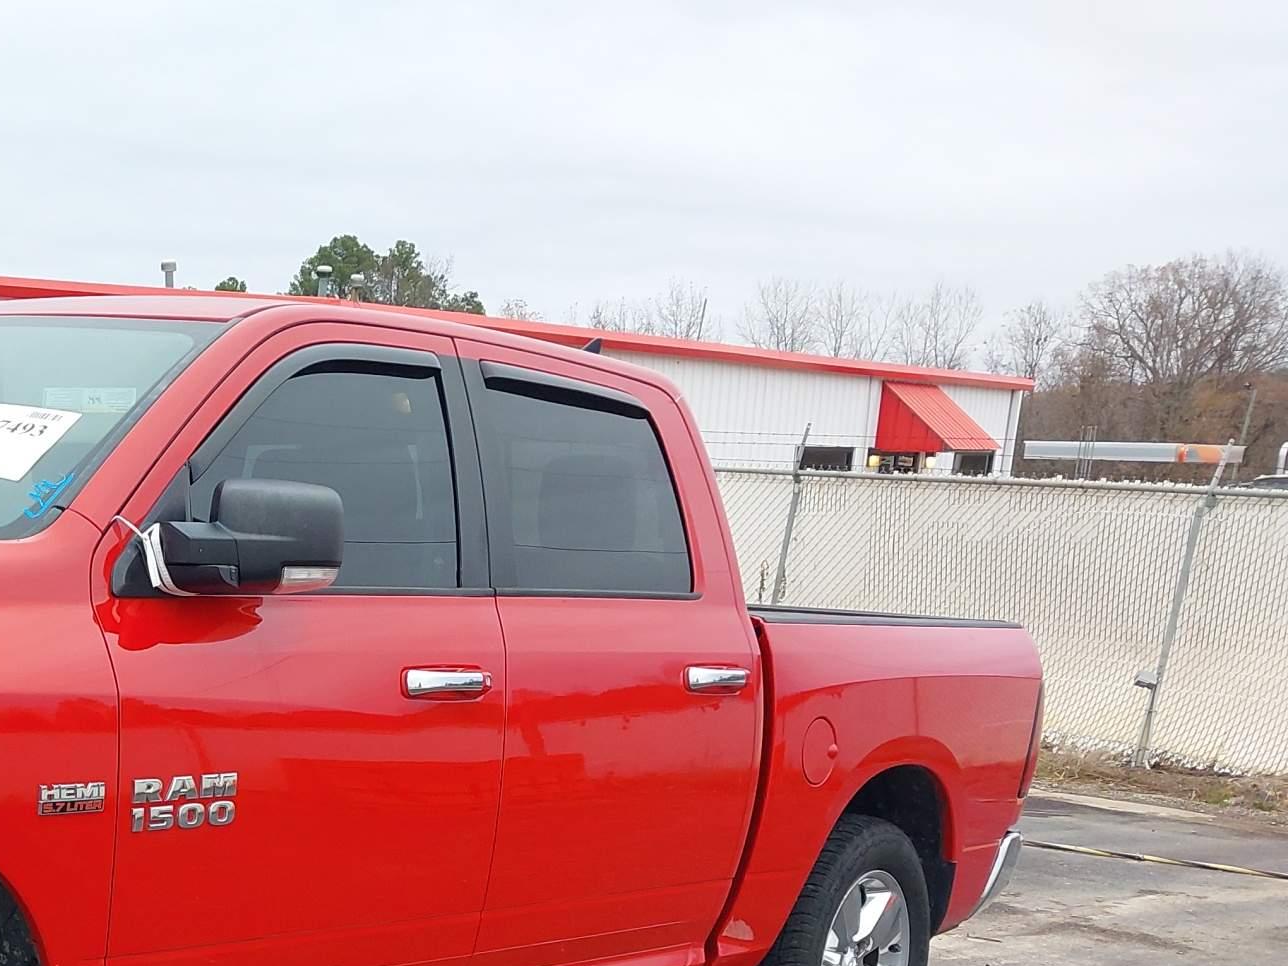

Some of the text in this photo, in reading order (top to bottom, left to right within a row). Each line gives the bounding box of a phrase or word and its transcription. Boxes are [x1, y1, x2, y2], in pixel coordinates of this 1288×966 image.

[39, 782, 106, 801] HEMI
[131, 772, 238, 804] RAM
[42, 800, 103, 813] 5.7 LITER
[131, 801, 236, 832] 1500
